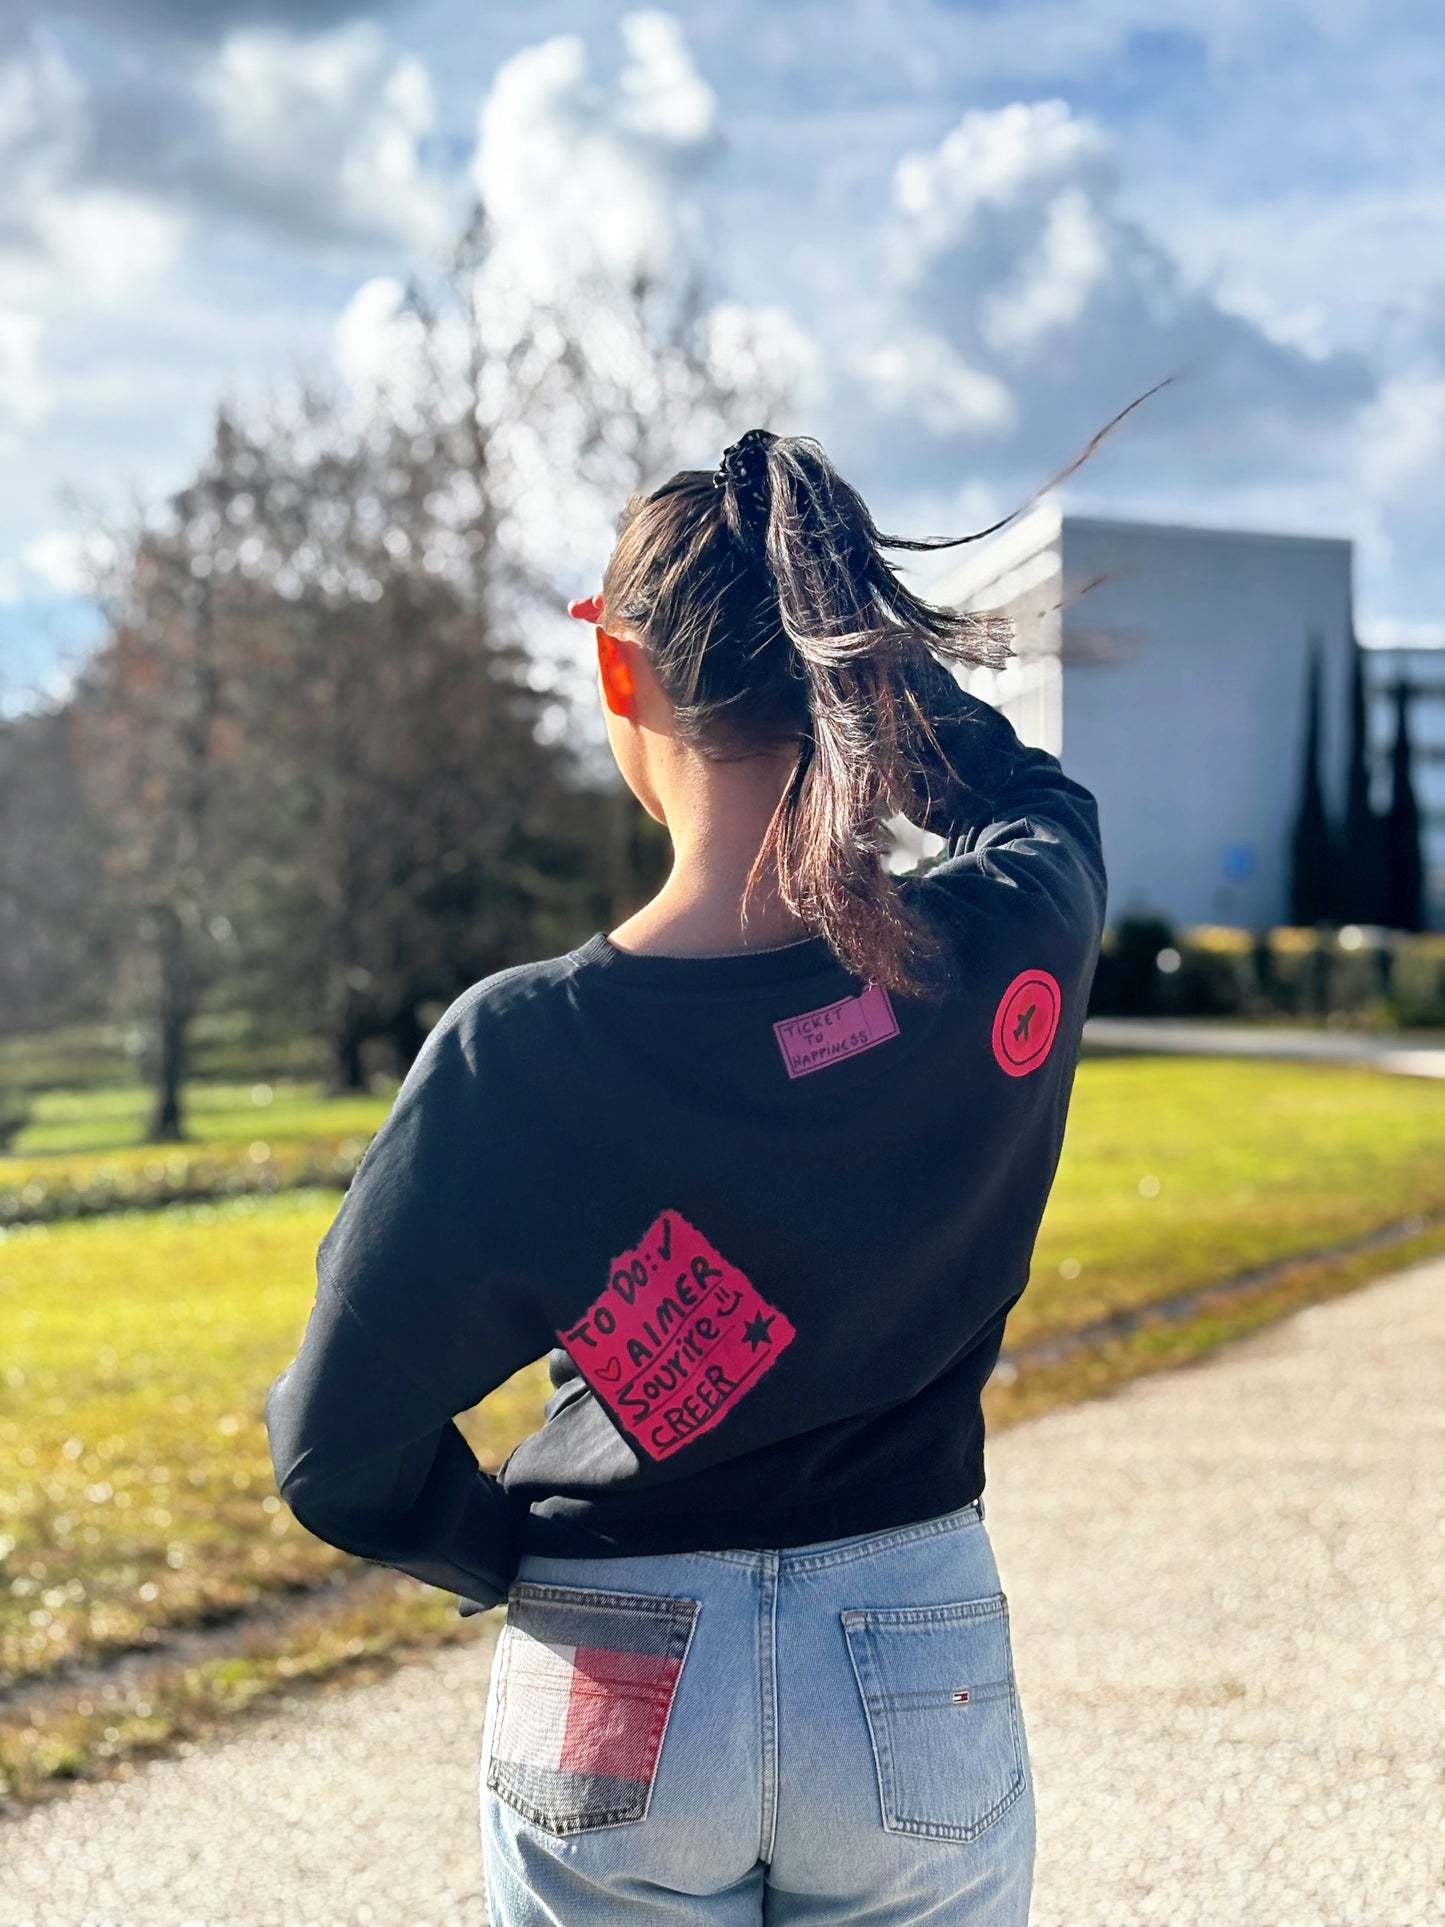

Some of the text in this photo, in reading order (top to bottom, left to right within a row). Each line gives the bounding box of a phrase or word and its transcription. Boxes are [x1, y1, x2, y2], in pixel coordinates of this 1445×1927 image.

[784, 1008, 842, 1037] TICKET
[804, 1033, 824, 1046] TO
[567, 1253, 658, 1347] TO DO:
[626, 1255, 723, 1367] AIMER
[650, 1364, 739, 1448] CREER
